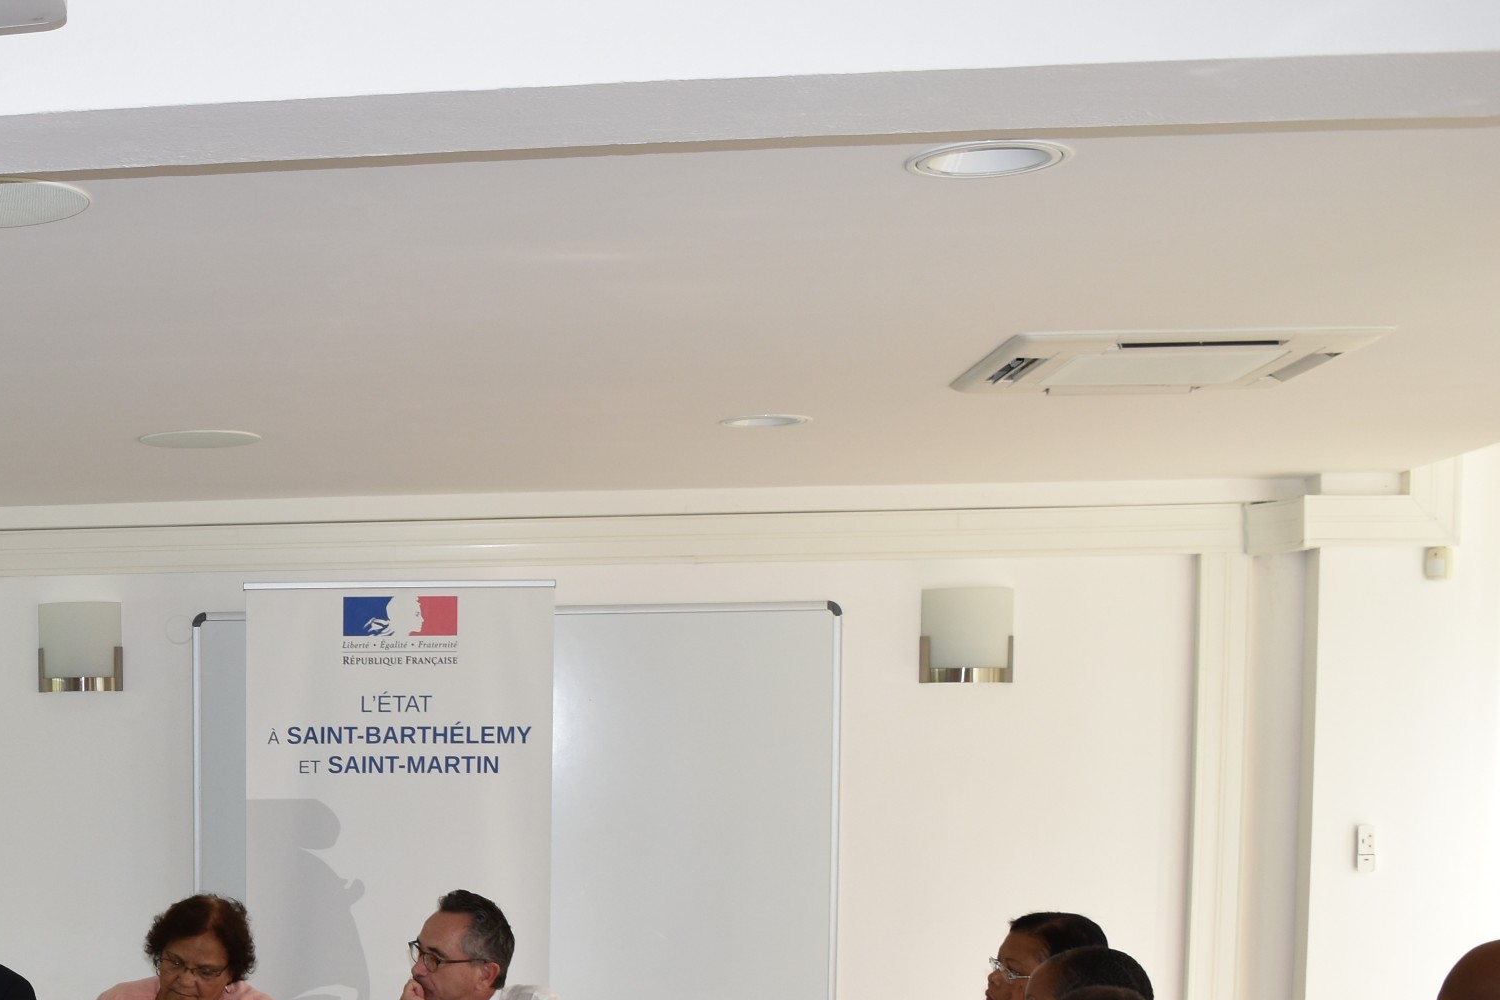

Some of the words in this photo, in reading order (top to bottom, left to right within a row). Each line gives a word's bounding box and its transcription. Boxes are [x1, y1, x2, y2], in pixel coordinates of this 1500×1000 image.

[342, 640, 370, 649] Liberté
[380, 639, 408, 651] Égalité
[418, 640, 458, 649] Fraternité
[342, 655, 403, 667] RÉPUBLIQUE
[405, 655, 458, 667] FRANÇAISE
[361, 691, 433, 713] L'ÉTAT
[267, 727, 280, 745] À
[287, 721, 532, 745] SAINT-BARTHÉLEMY
[299, 760, 321, 774] ET
[328, 755, 499, 774] SAINT-MARTIN
